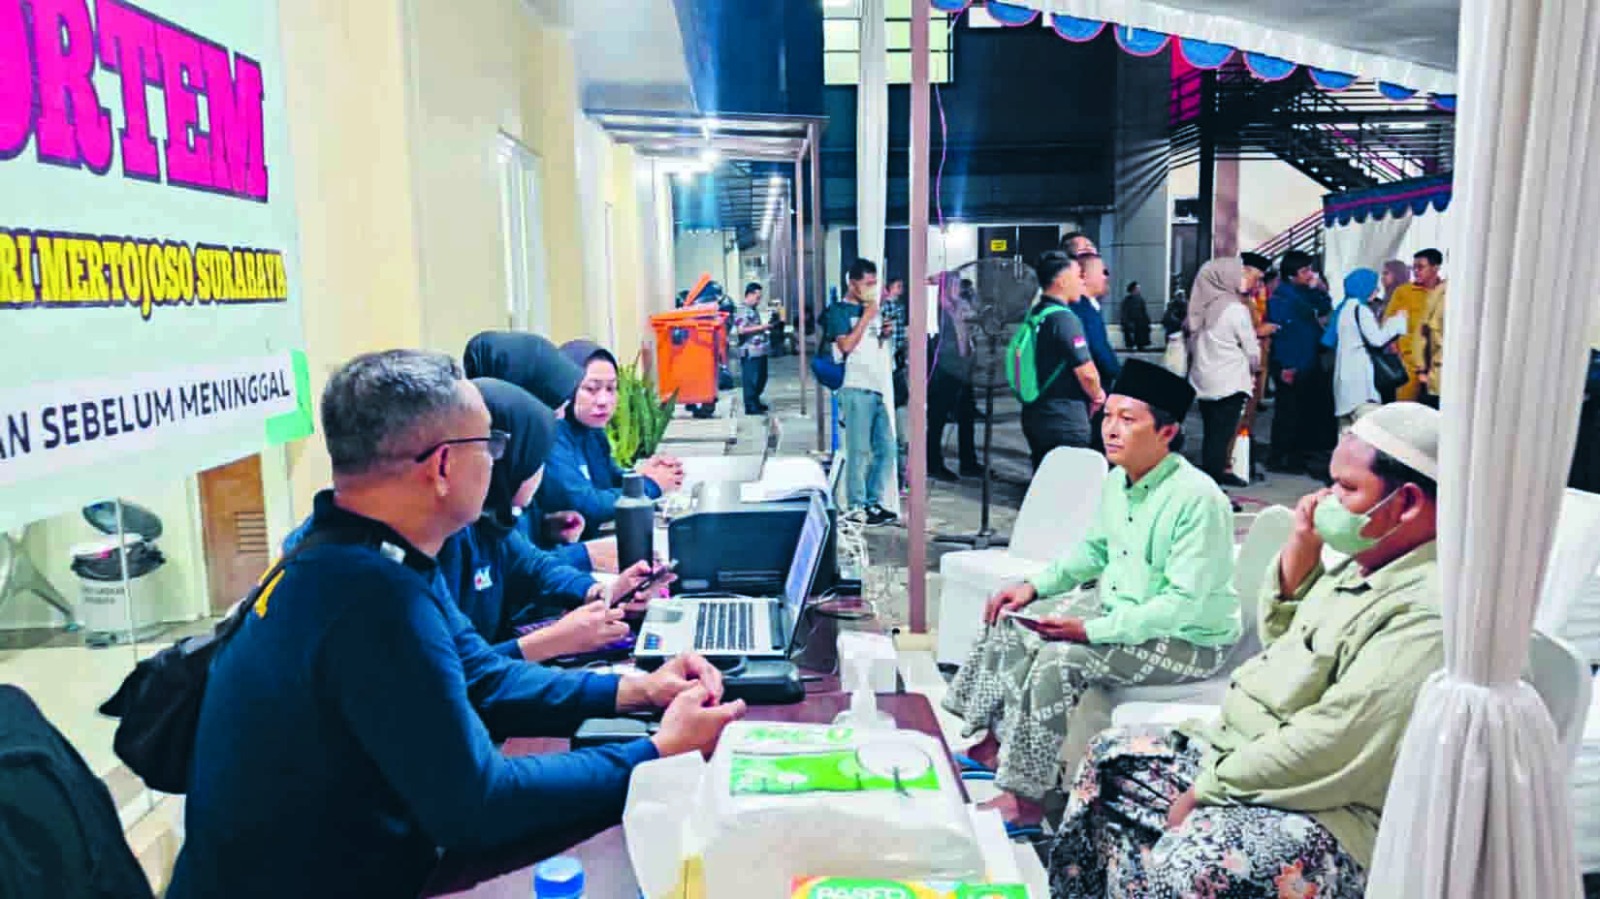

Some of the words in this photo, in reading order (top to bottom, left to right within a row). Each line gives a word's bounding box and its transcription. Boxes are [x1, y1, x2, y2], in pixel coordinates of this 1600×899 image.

[35, 229, 194, 320] MERTOJOSO
[194, 242, 287, 304] SURABAYA
[41, 387, 174, 450] SEBELUM
[179, 369, 290, 419] MENINGGAL
